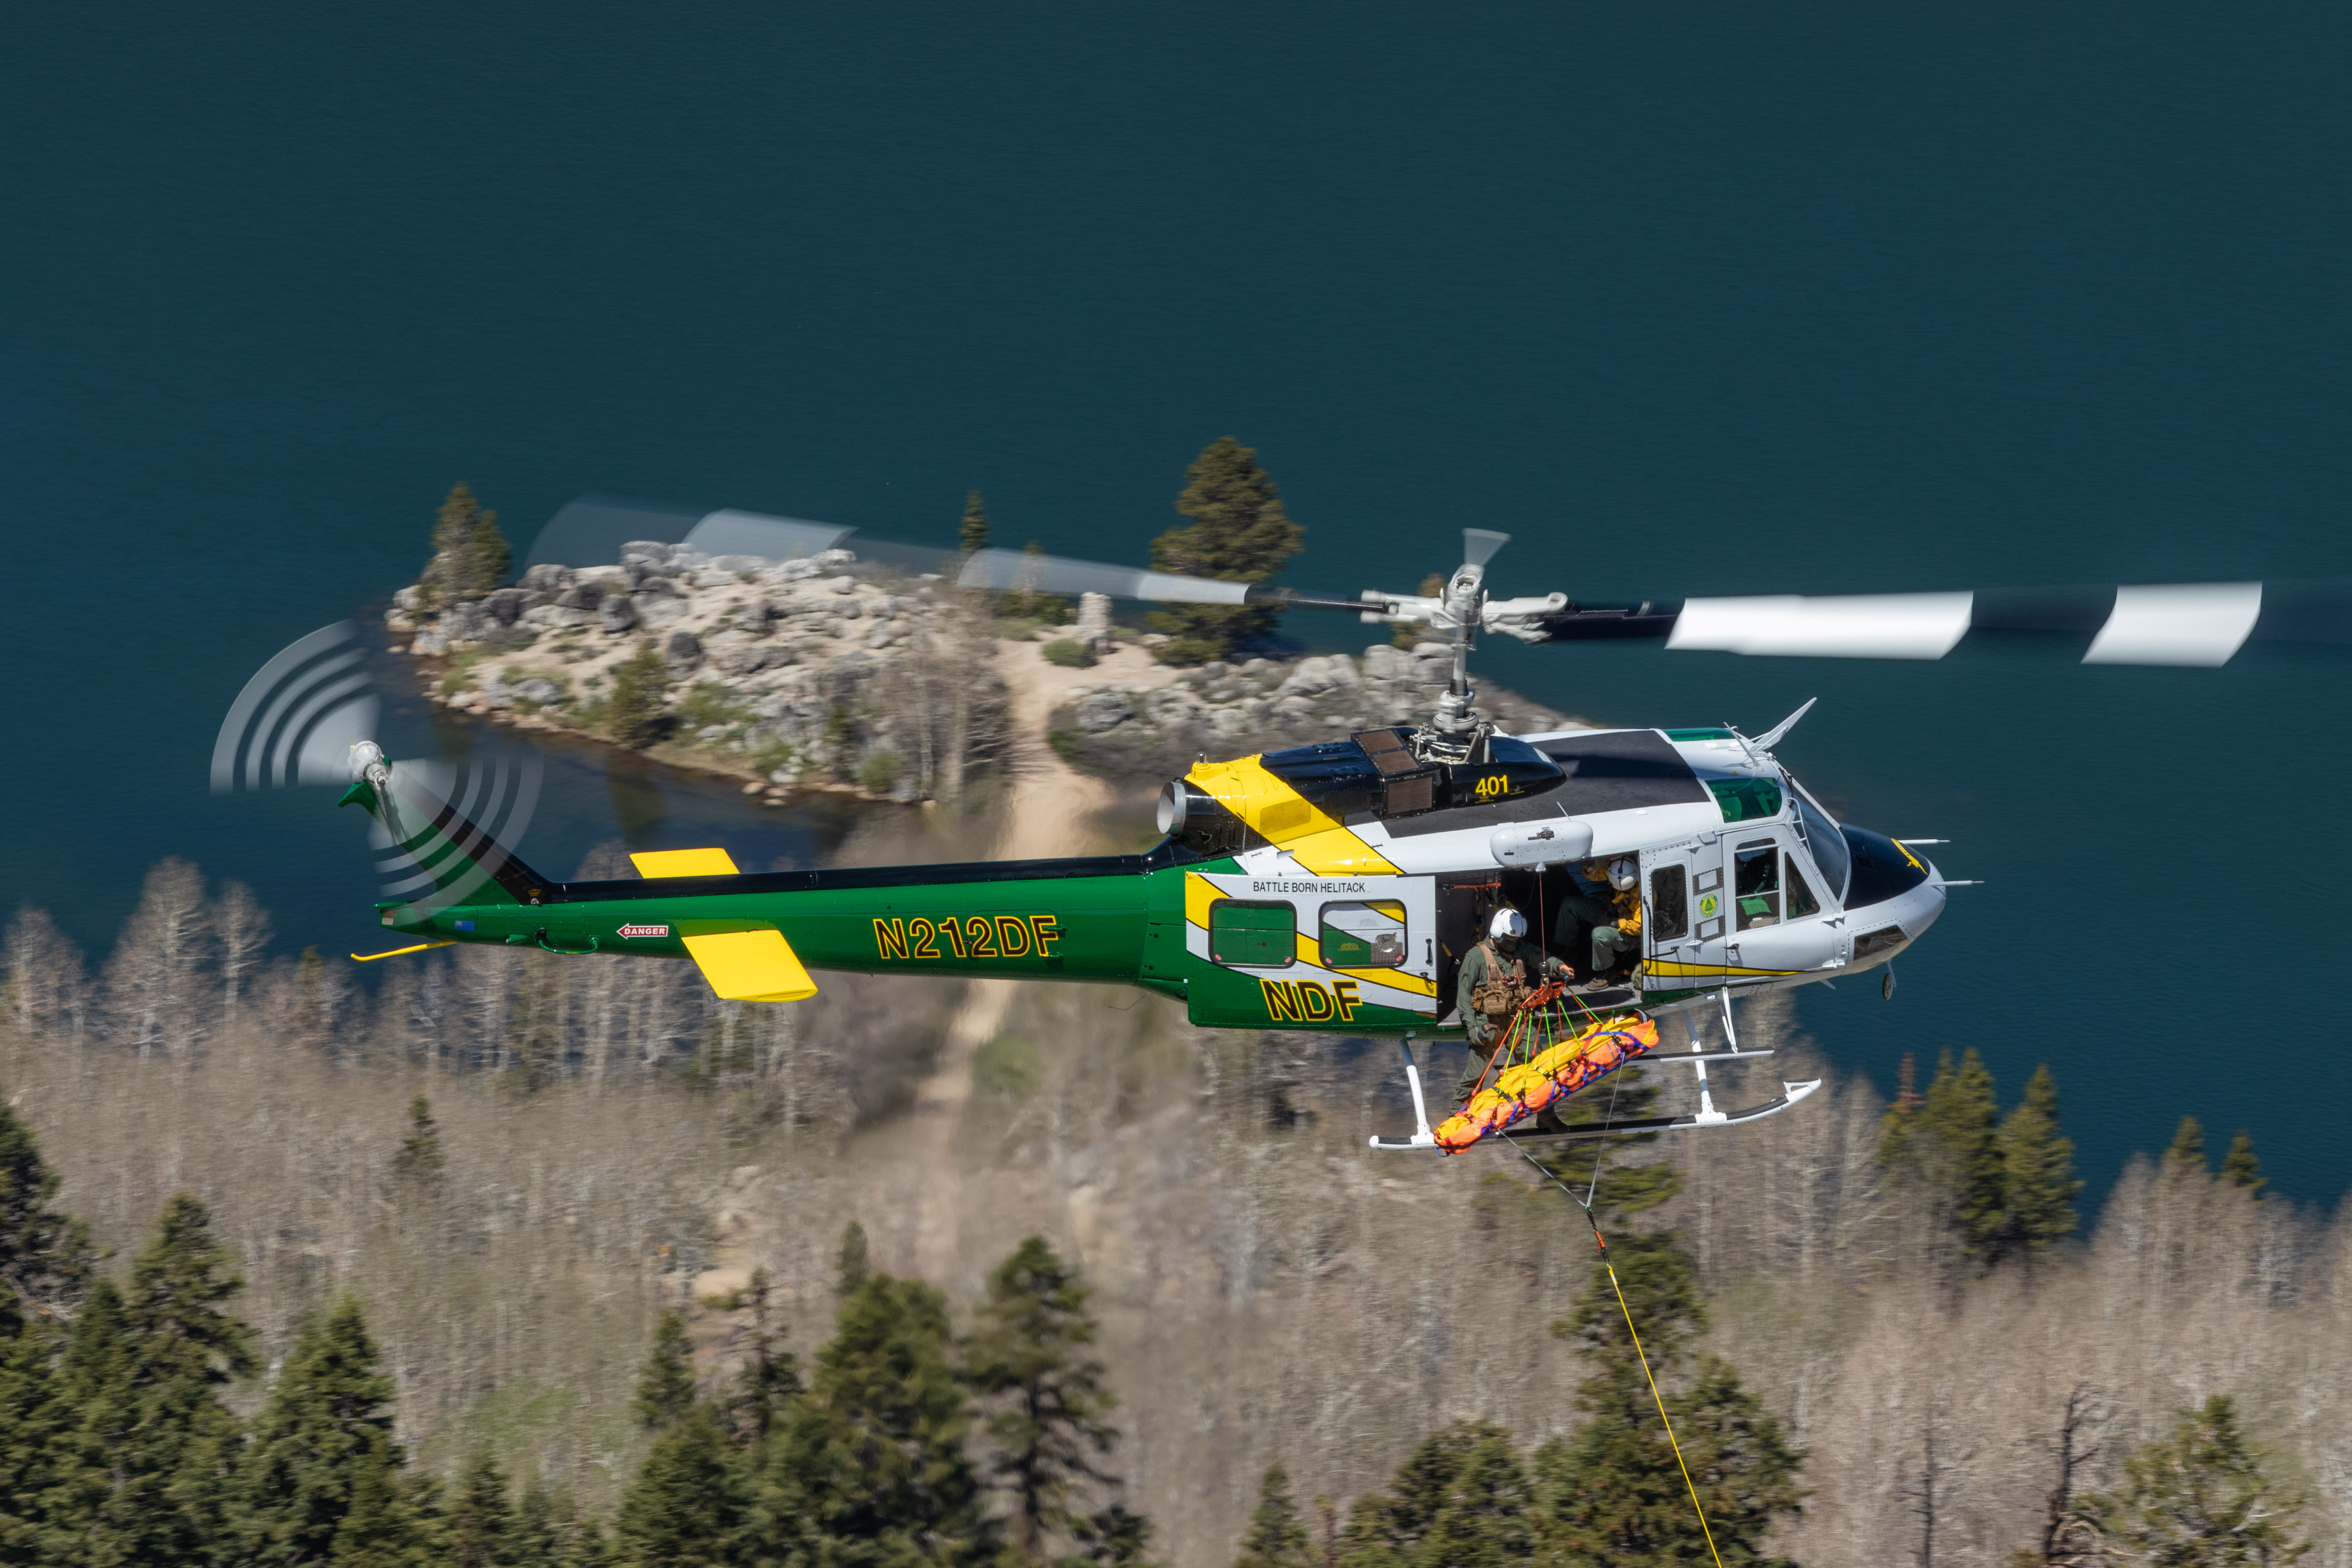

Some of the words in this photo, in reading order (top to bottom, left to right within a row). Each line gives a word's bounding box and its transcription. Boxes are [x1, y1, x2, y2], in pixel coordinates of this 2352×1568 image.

[1475, 775, 1508, 796] 401
[1253, 882, 1289, 892] BATTLE
[1292, 883, 1317, 893] BORN
[1321, 882, 1365, 893] HELITACK
[873, 915, 1059, 959] N212DF
[1259, 979, 1363, 1022] NDF
